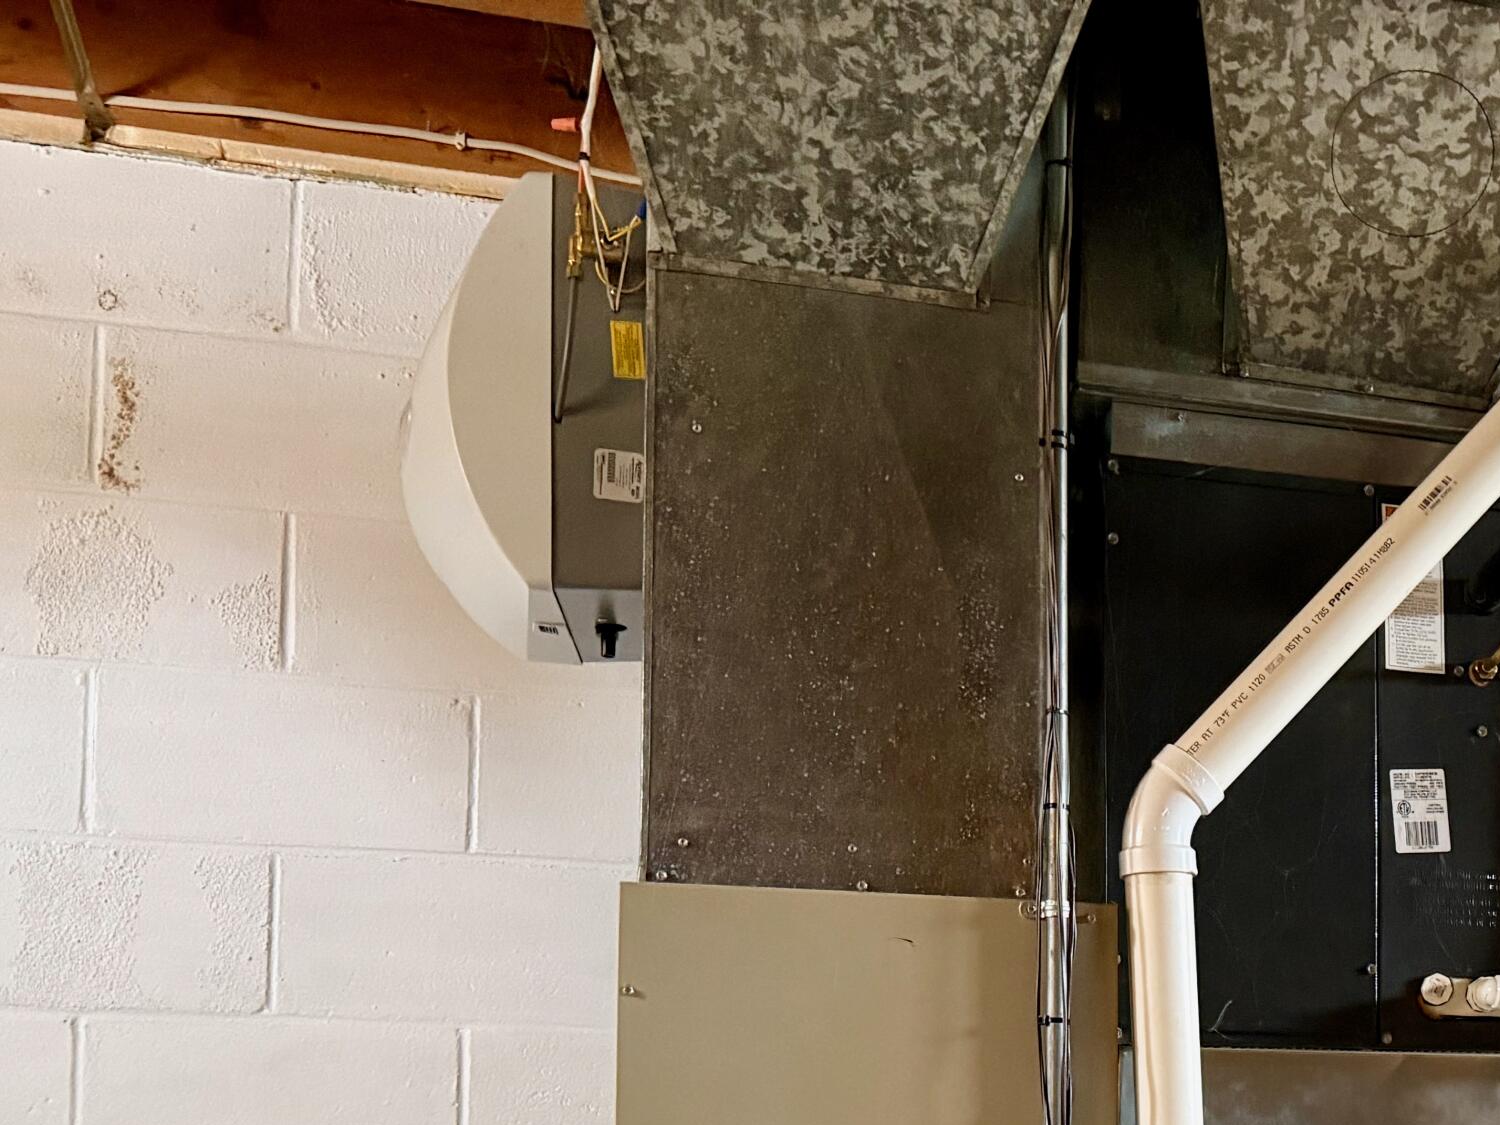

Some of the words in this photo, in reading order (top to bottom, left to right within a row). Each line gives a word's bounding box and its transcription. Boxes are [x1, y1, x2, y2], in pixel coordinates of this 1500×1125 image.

[1201, 727, 1214, 742] AT
[1231, 692, 1249, 710] PVC
[1248, 673, 1266, 692] 1120
[1284, 634, 1304, 653] ASTM
[1302, 625, 1311, 634] D
[1312, 606, 1330, 625] 1785
[1328, 581, 1354, 607] PPFA
